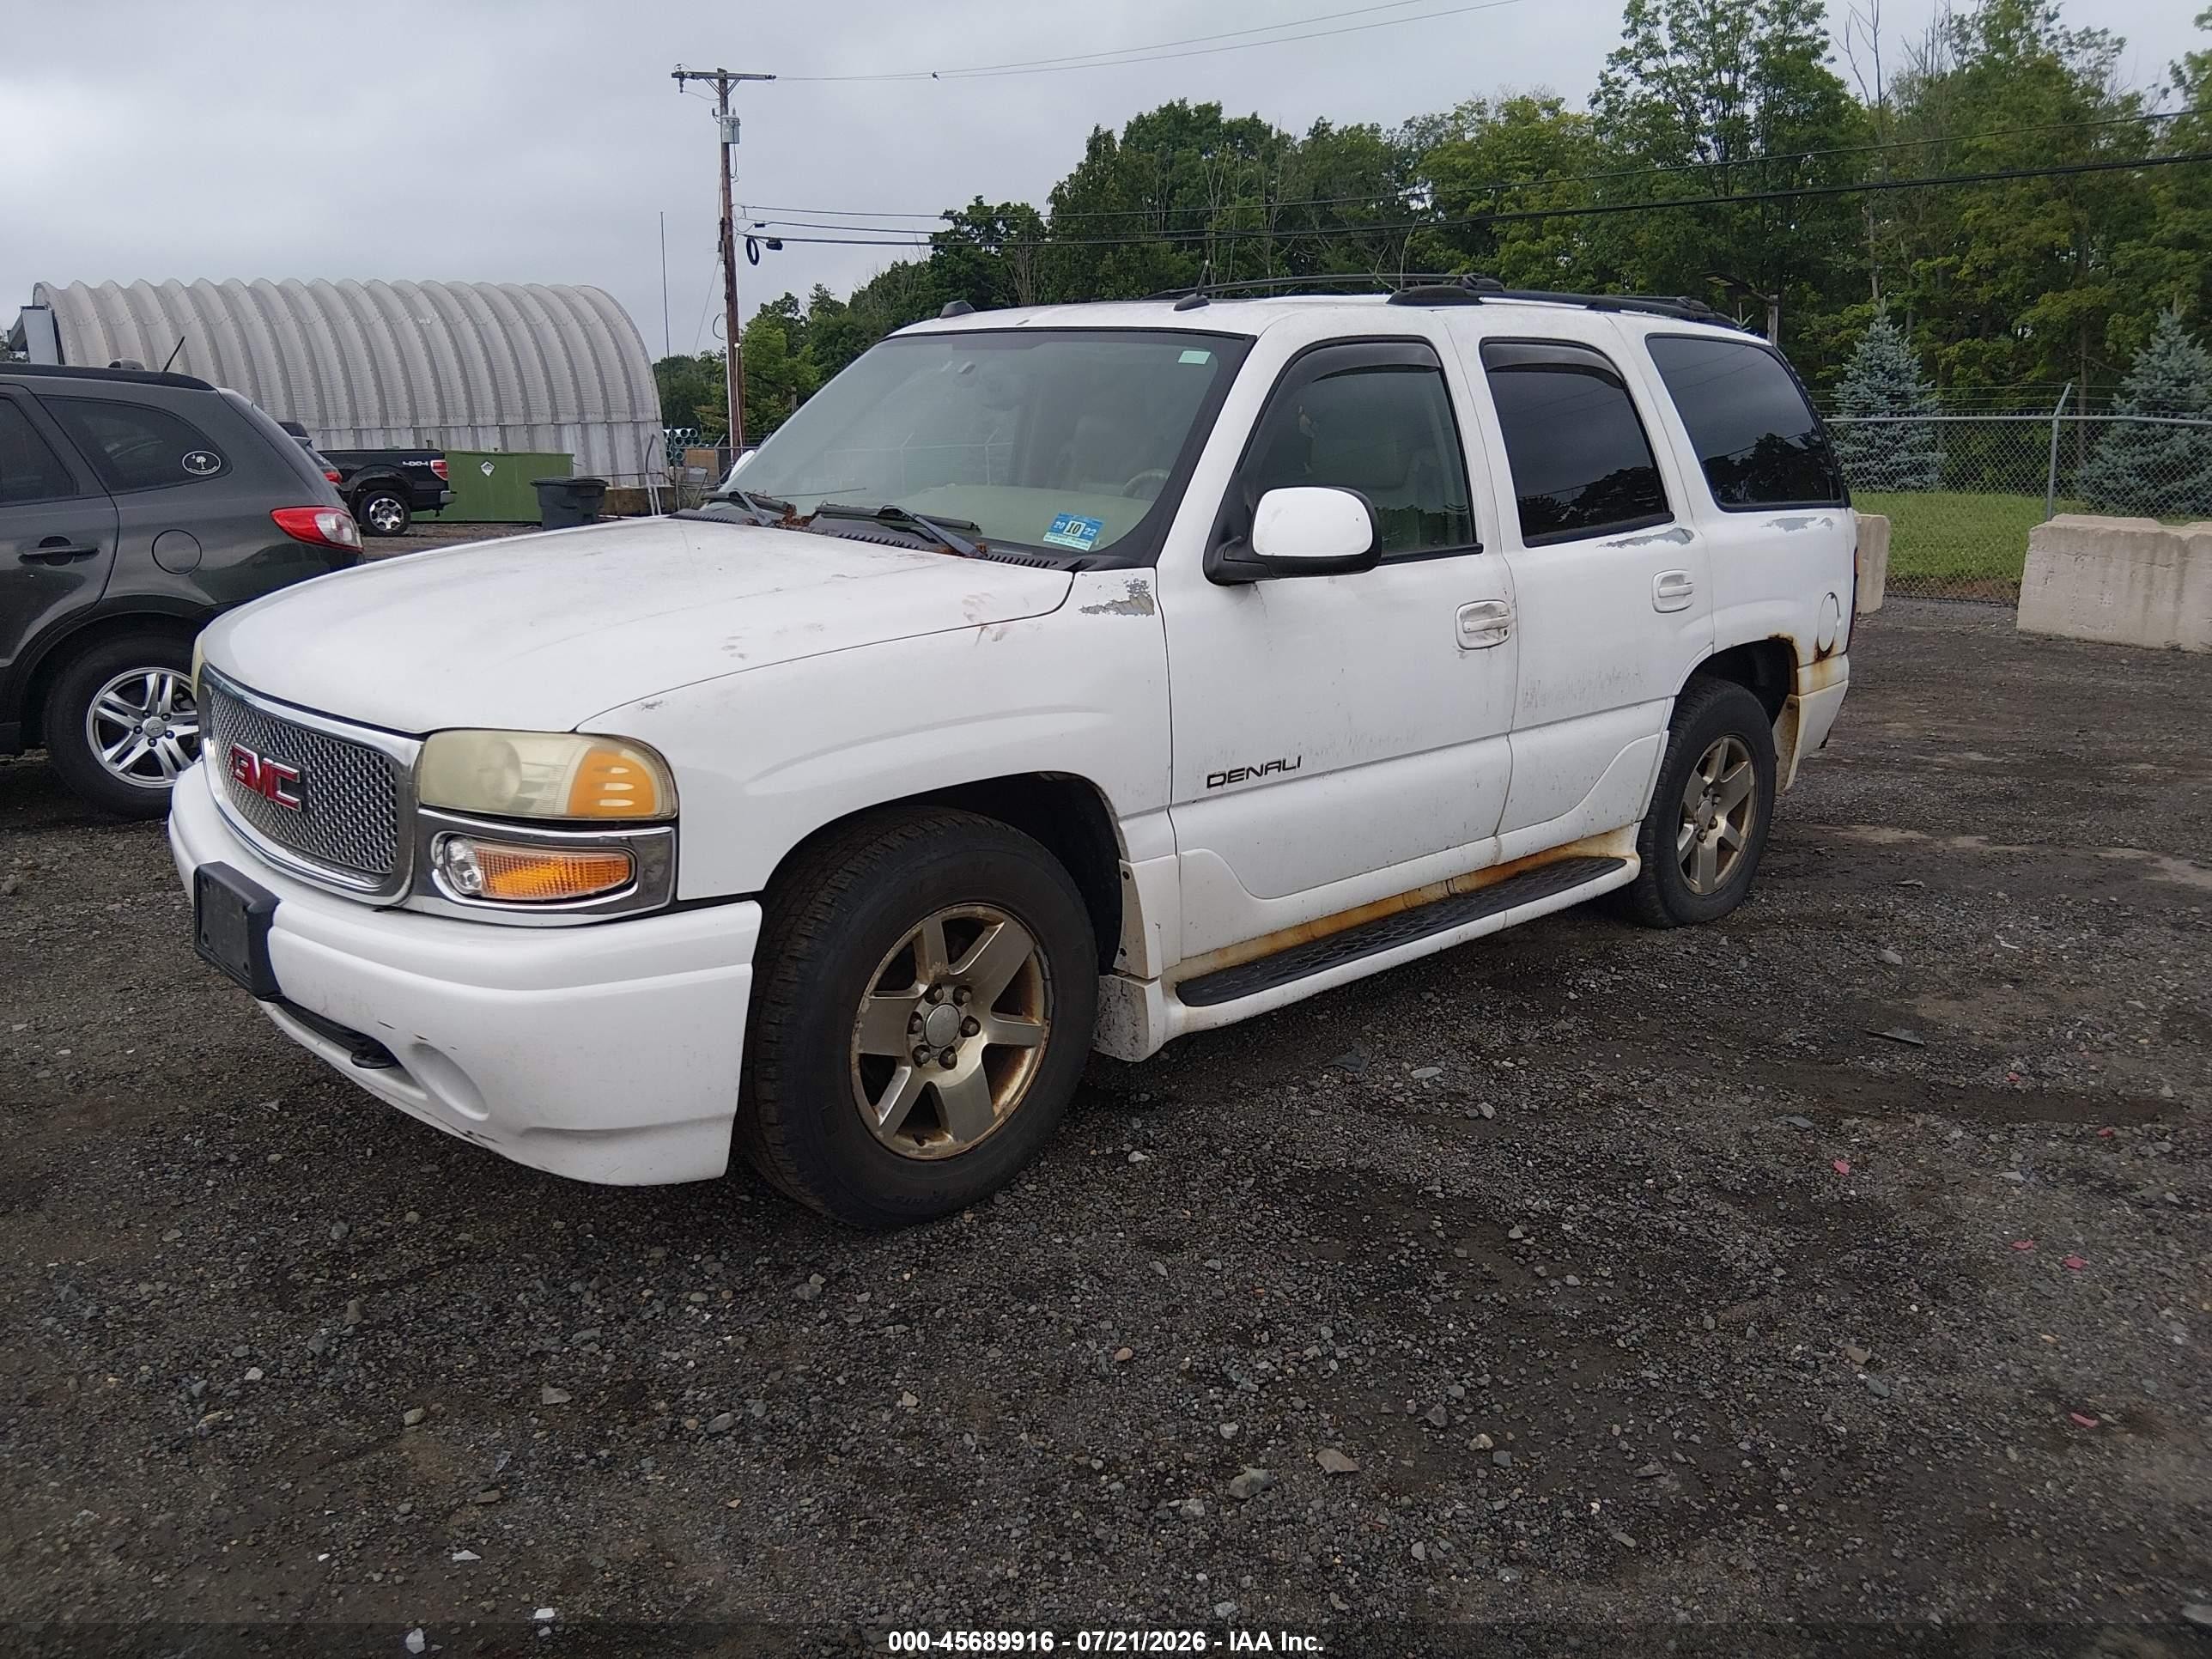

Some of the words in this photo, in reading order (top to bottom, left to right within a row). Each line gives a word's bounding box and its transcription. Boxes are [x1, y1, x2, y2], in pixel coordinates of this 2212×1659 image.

[1053, 521, 1066, 530] 20
[1066, 522, 1082, 535] 10
[1083, 527, 1097, 537] 22
[232, 742, 302, 812] GMC
[1206, 755, 1301, 788] DENALI
